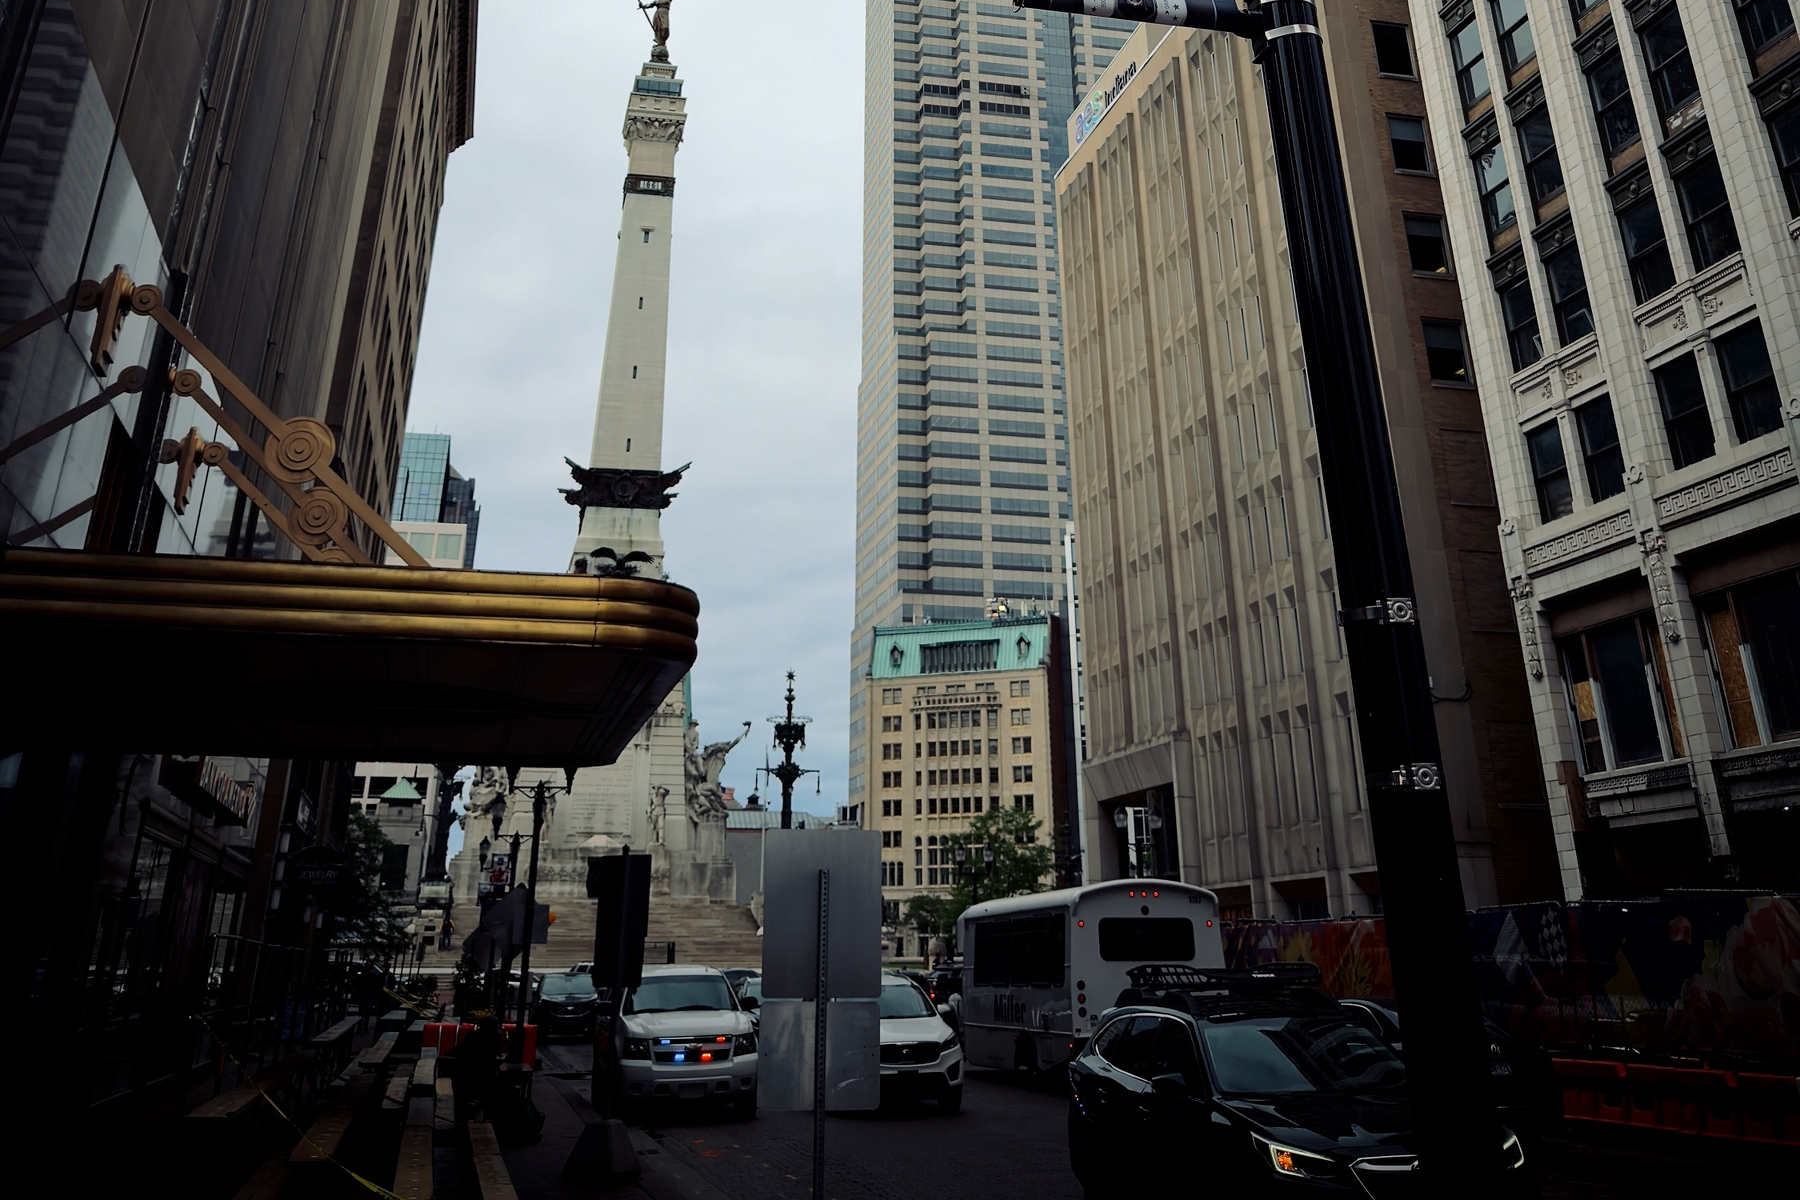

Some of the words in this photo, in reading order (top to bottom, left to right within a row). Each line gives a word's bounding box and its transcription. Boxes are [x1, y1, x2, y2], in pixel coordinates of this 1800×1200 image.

[1075, 90, 1102, 145] aes
[1104, 61, 1137, 108] Indiana
[297, 870, 338, 879] JEWELRY
[994, 994, 1027, 1023] Miller
